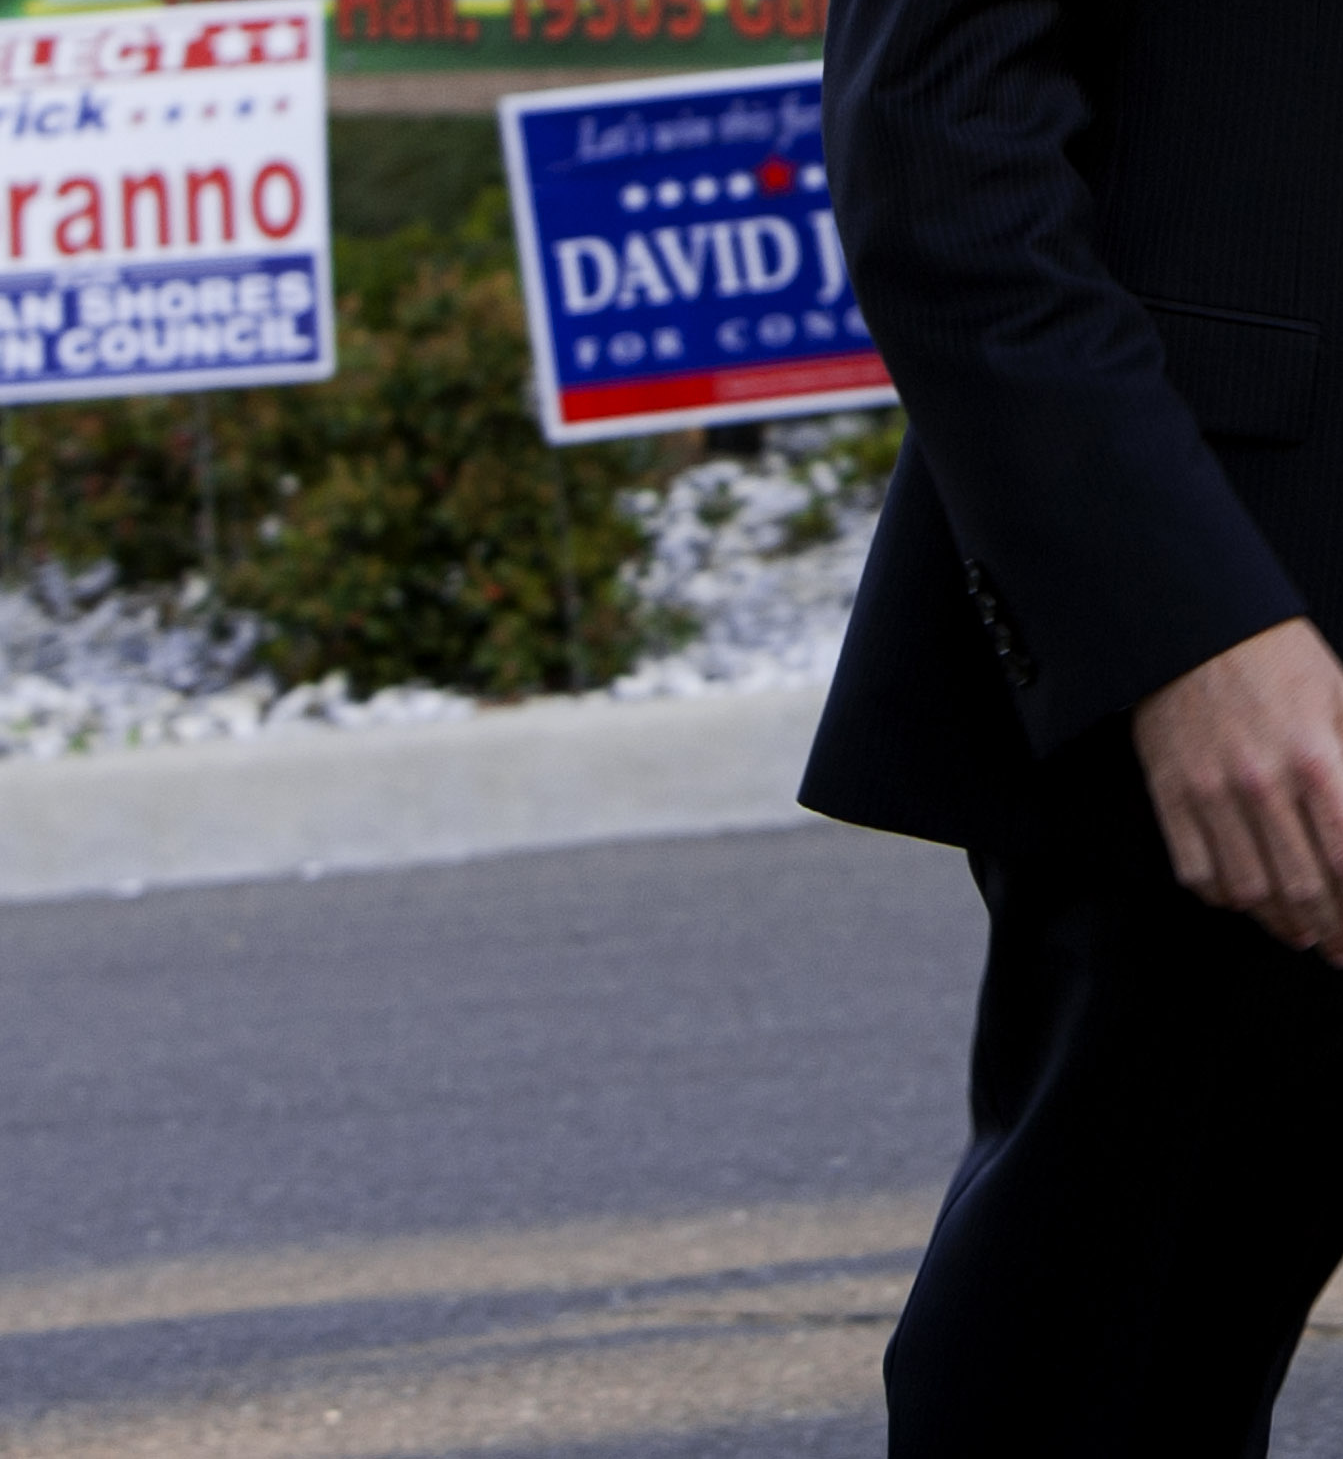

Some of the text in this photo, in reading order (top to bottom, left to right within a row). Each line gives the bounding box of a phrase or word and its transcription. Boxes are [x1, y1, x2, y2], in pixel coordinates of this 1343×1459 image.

[0, 89, 108, 138] ick
[8, 159, 306, 259] ranno
[553, 213, 803, 318] DAVID
[76, 269, 313, 330] SHORES
[57, 310, 313, 375] COUNCIL
